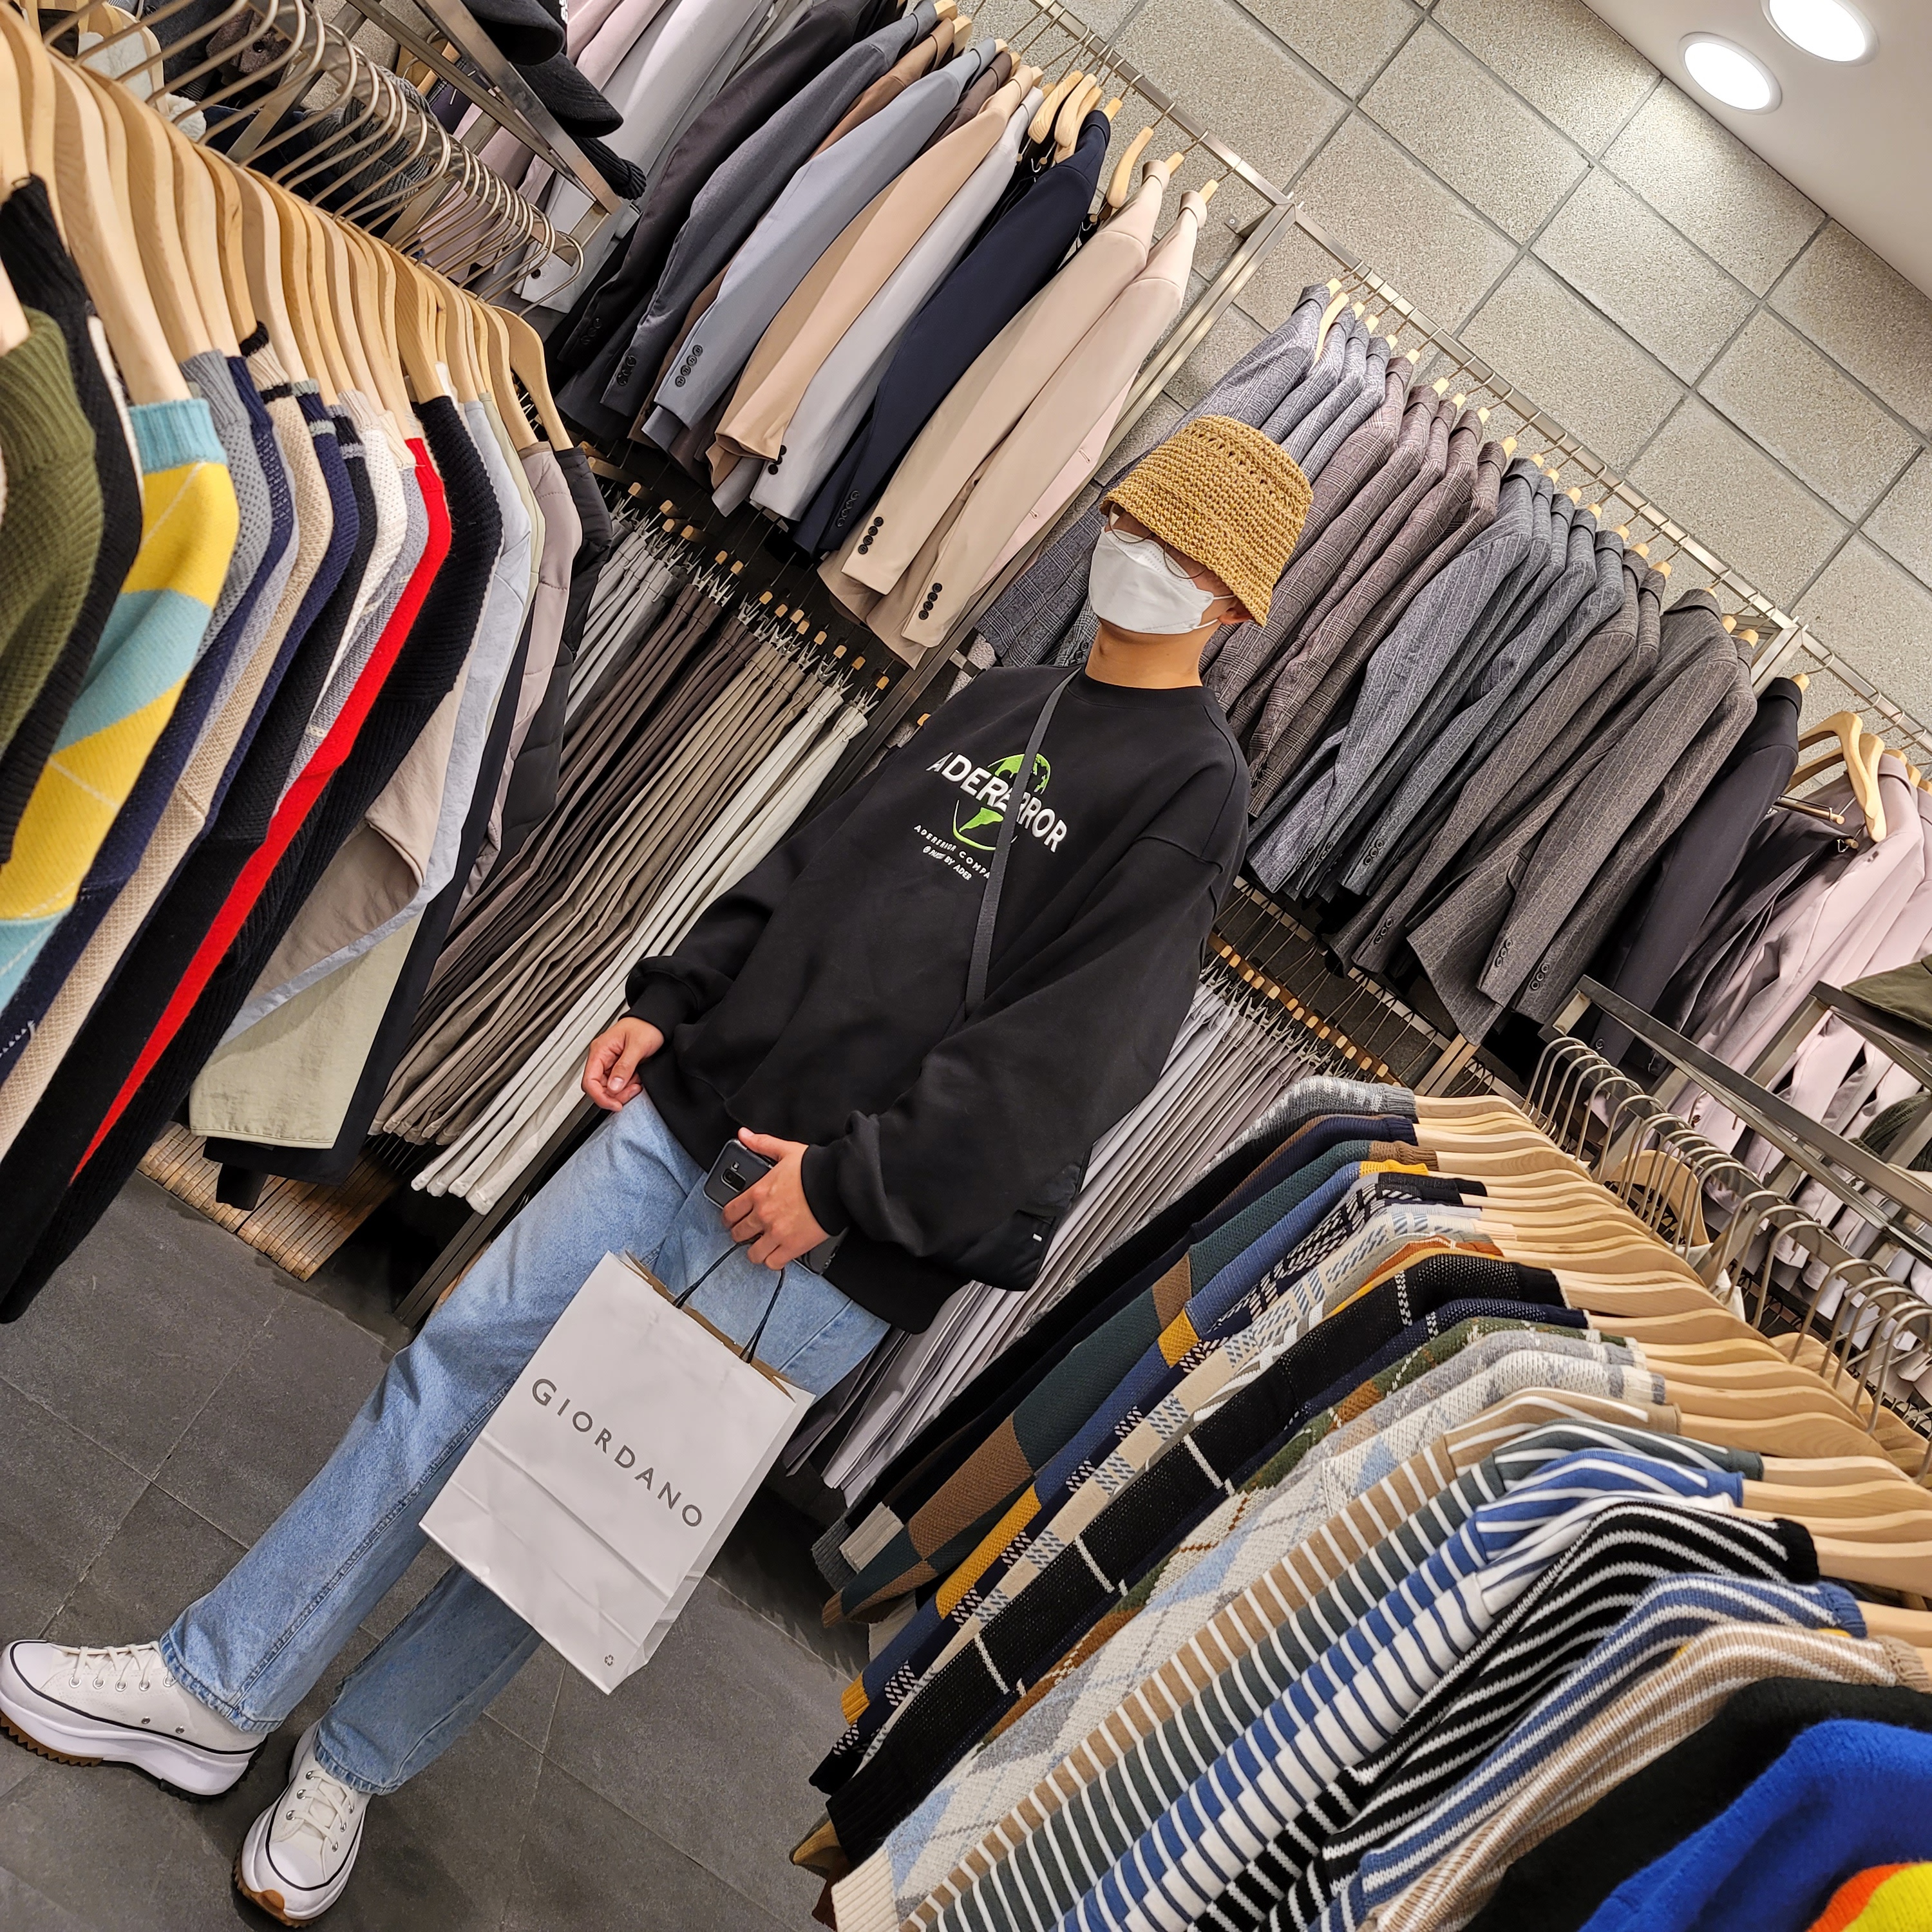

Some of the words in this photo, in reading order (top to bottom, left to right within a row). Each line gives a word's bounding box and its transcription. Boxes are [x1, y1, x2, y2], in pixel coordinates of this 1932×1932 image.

[943, 855, 956, 866] BY
[952, 864, 972, 880] ADER
[959, 851, 990, 879] COMPA
[531, 1378, 703, 1528] GIORDANO
